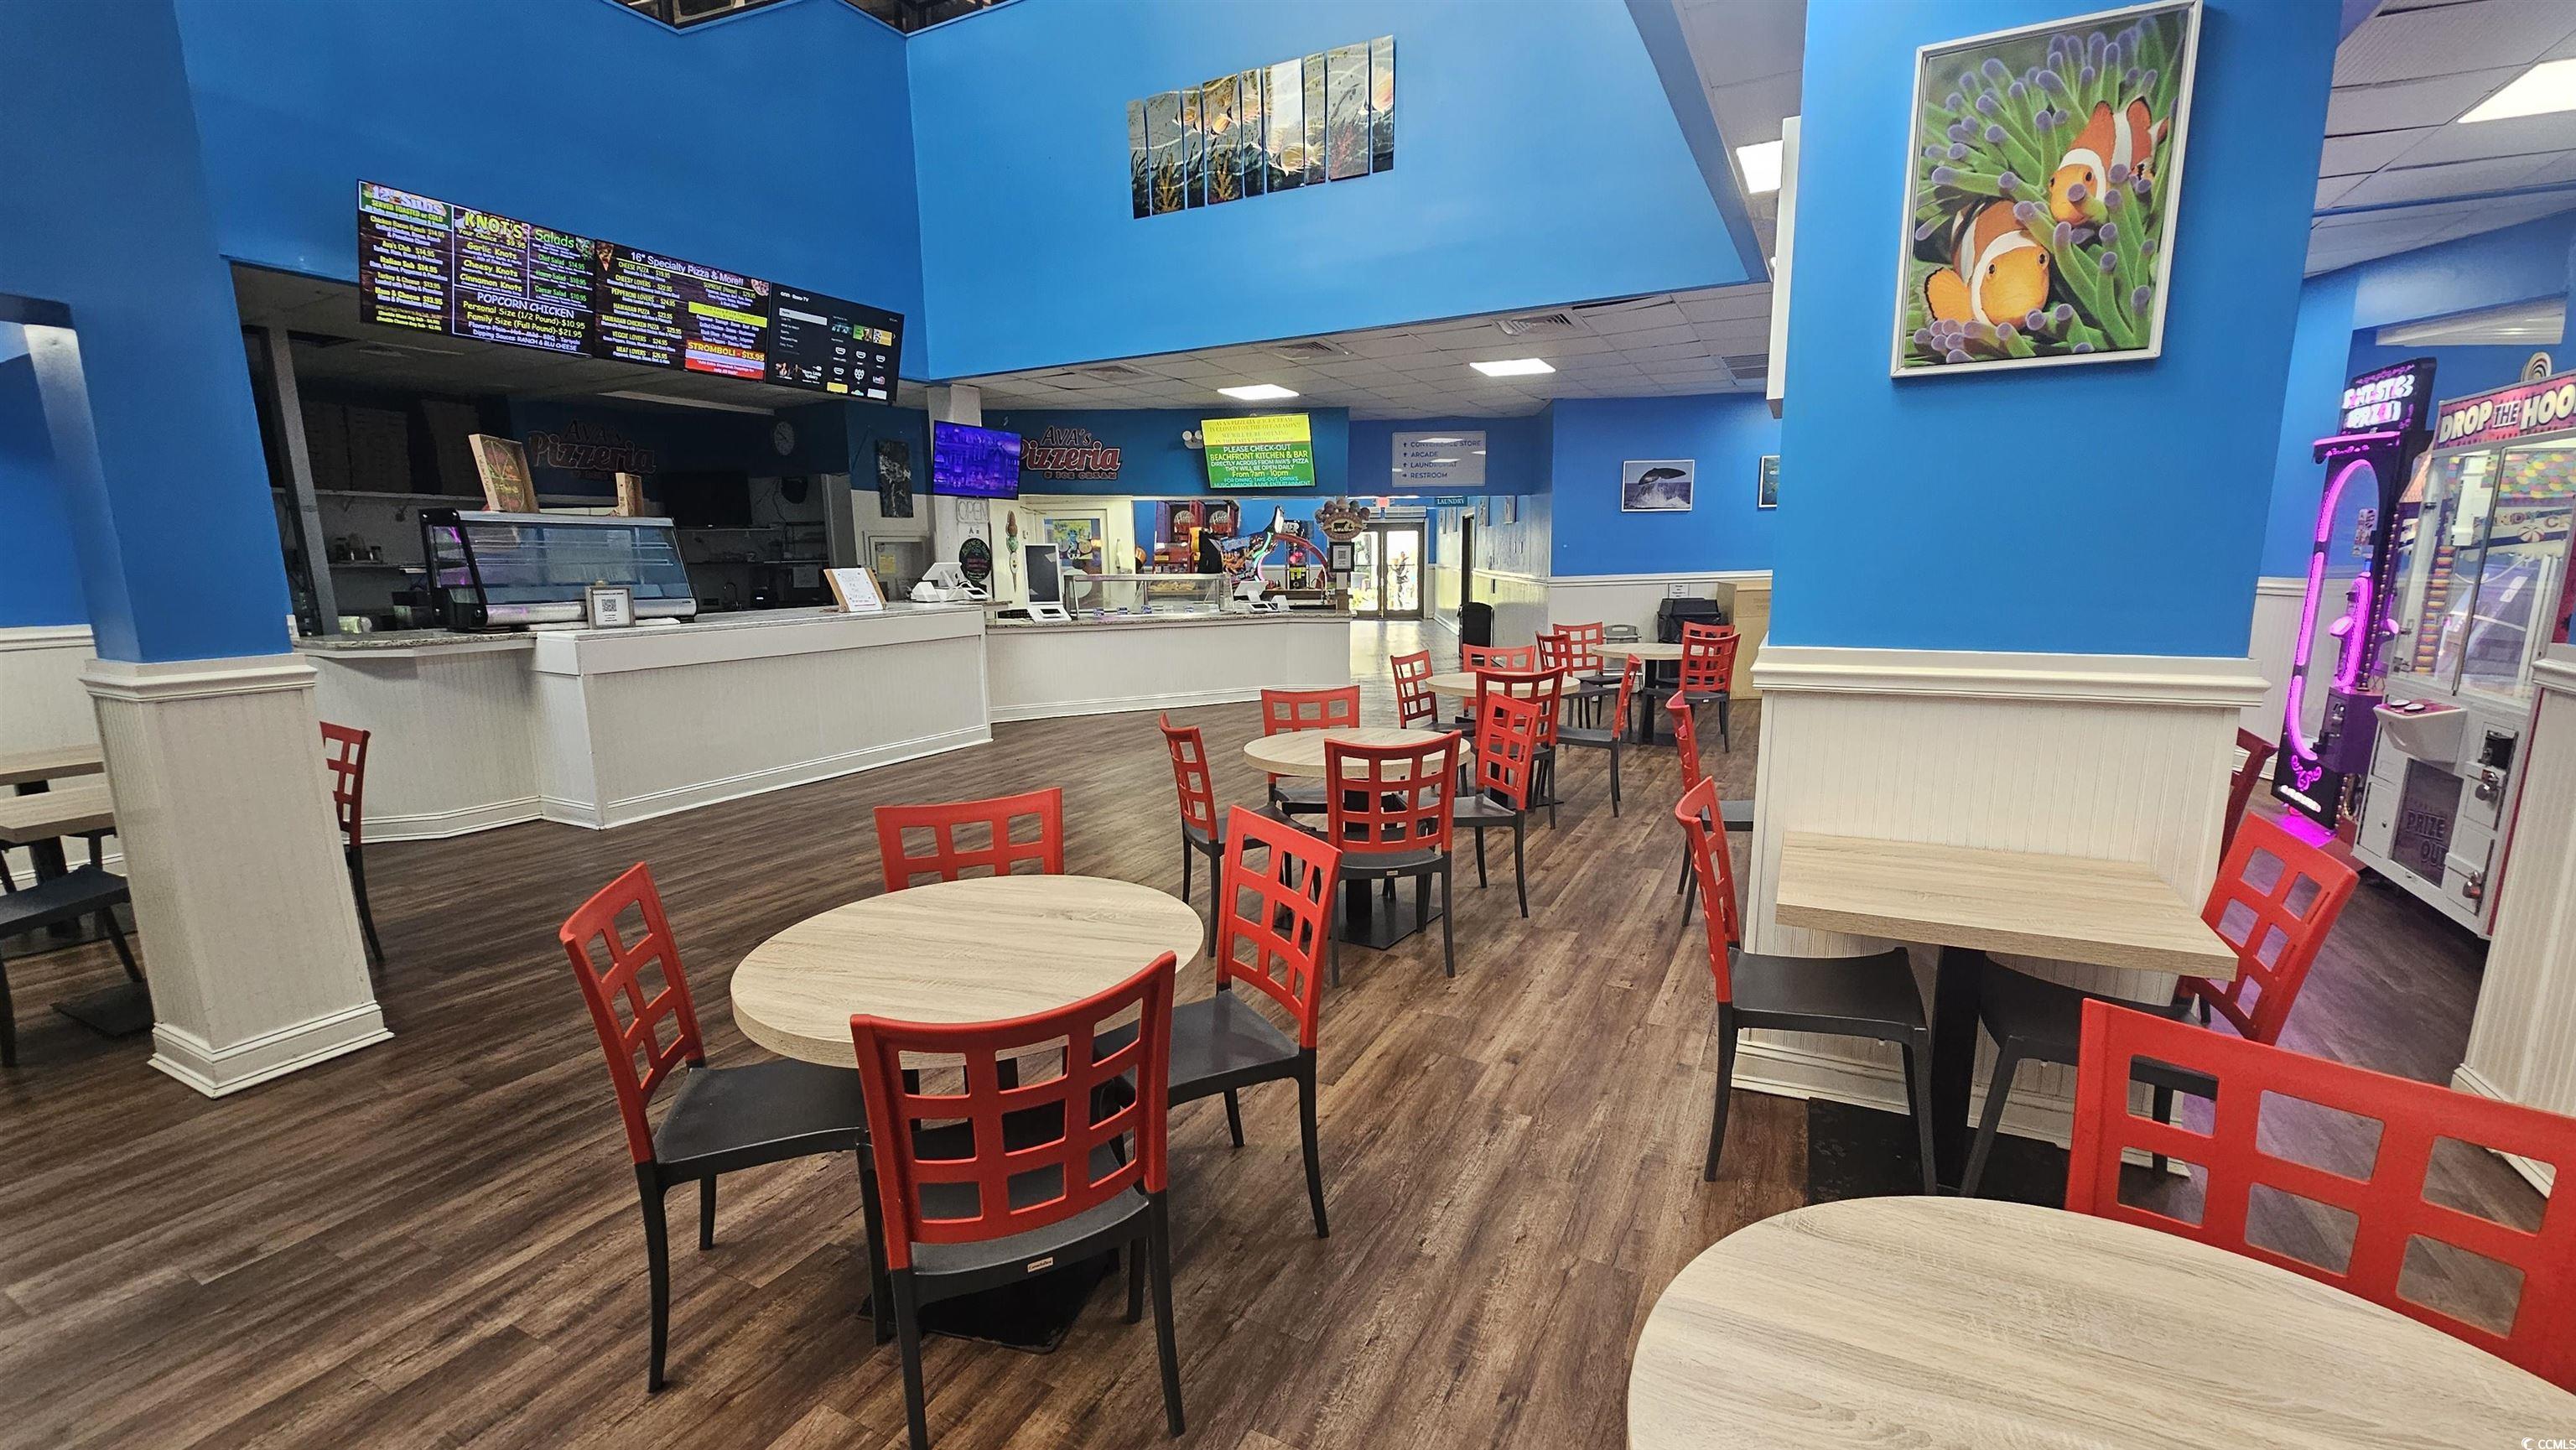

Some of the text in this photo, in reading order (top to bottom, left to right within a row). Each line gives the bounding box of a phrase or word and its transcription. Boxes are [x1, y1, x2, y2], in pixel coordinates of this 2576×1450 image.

[465, 211, 523, 239] KNOT'S
[535, 230, 574, 248] Salads
[466, 242, 491, 253] Garlic
[495, 247, 518, 260] Knots
[463, 259, 493, 273] Cheesy
[496, 266, 518, 277] Knots
[631, 252, 744, 286] 16" Specialty Pizza & More!!
[460, 273, 498, 287] Cinnamon
[500, 280, 522, 292] Knots
[463, 300, 496, 314] Personal
[498, 305, 517, 318] Size
[517, 310, 533, 320] (1/2
[477, 293, 528, 310] POPCORN
[530, 303, 574, 319] CHICKEN
[637, 307, 651, 315] PIZZA
[466, 312, 493, 324] Family
[495, 316, 512, 327] Size
[513, 320, 530, 330] (Full
[647, 322, 660, 330] PIZZA
[473, 329, 495, 339] Dipping
[517, 335, 538, 346] RANCH
[555, 342, 577, 352] CHEESE
[688, 342, 735, 356] STROMBOLI
[741, 350, 765, 361] $13.95
[2438, 398, 2494, 444] DROP
[2495, 403, 2520, 426] THE
[2520, 383, 2576, 430] HOO
[1041, 425, 1093, 447] AVA's
[527, 429, 657, 475] Pizzeria
[1210, 453, 1254, 461] BEACHFRONT
[1255, 451, 1285, 460] KITCHEN
[1250, 444, 1291, 453] CHECK-OUT
[1055, 471, 1074, 480] ICE
[1270, 470, 1289, 478] 10pm
[958, 500, 989, 521] OPEN
[2405, 809, 2446, 842] PRIZE
[2420, 839, 2449, 870] OUT
